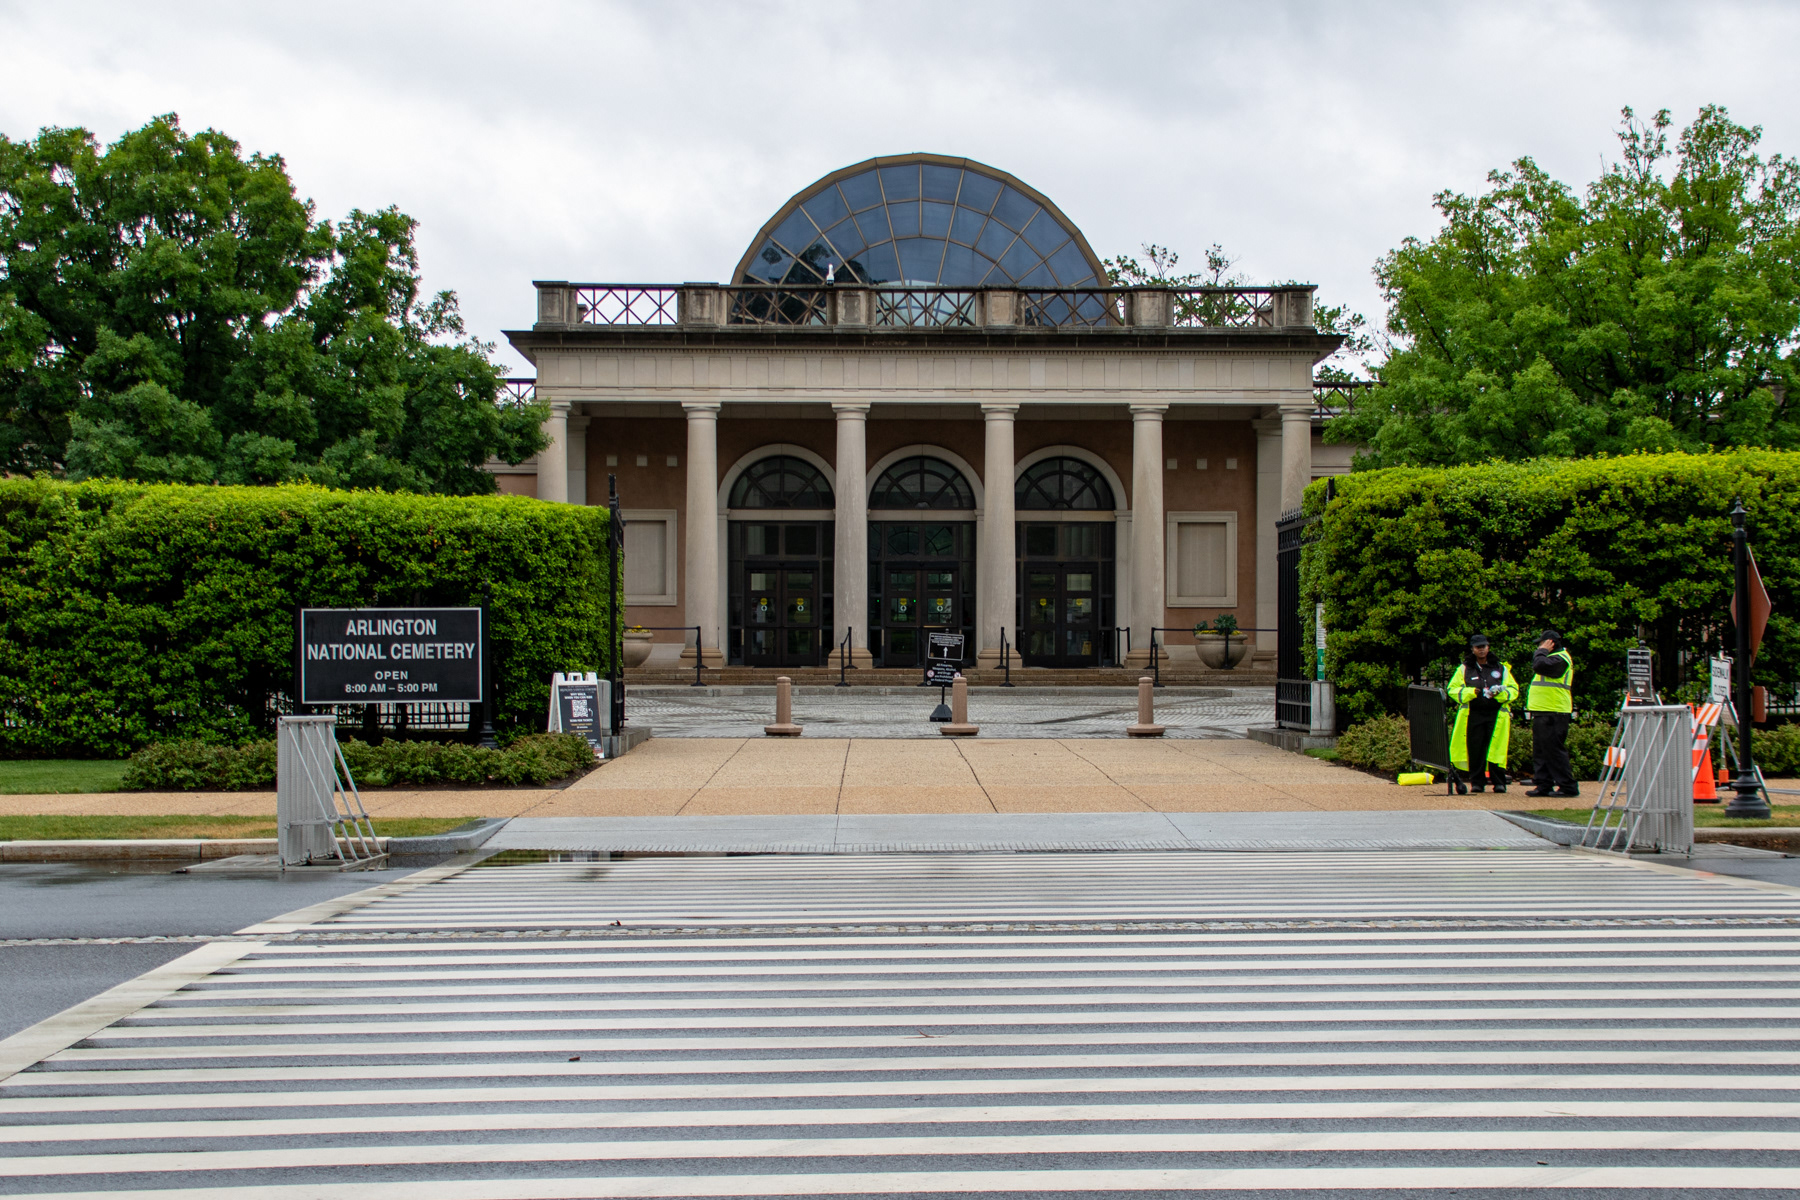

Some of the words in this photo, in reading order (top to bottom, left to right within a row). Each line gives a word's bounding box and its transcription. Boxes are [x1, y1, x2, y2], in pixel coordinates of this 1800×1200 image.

[345, 619, 437, 636] ARLINGTON
[307, 643, 387, 660] NATIONAL
[390, 642, 476, 660] CEMETERY
[374, 670, 409, 680] OPEN
[345, 684, 367, 693] 8:00
[369, 684, 387, 693] AM
[397, 683, 419, 693] 5:00
[421, 683, 438, 693] PM
